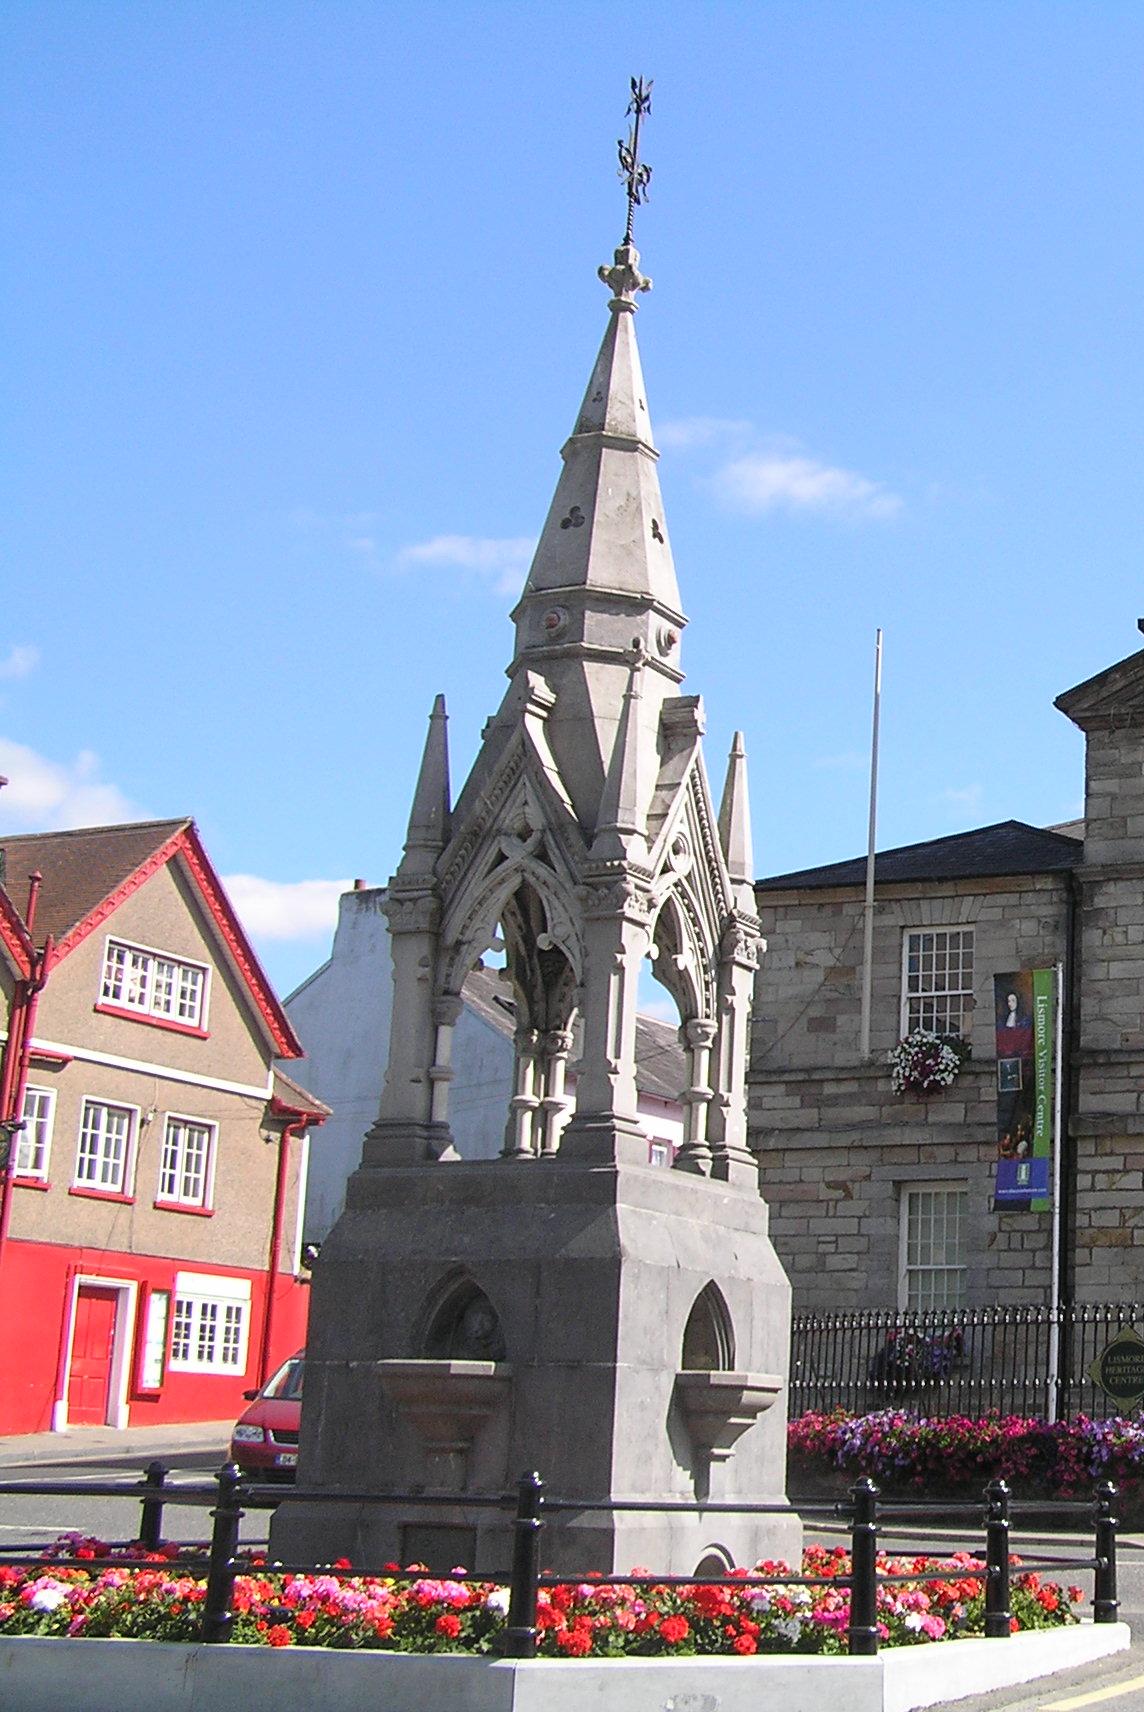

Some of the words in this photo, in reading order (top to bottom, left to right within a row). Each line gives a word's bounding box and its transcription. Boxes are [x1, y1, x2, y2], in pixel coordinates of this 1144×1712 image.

[1036, 995, 1047, 1045] Lismore
[1037, 1049, 1047, 1092] Visitor
[1036, 1094, 1047, 1137] Centre
[1107, 1354, 1144, 1363] LISMORE
[1109, 1375, 1144, 1385] CENTRE
